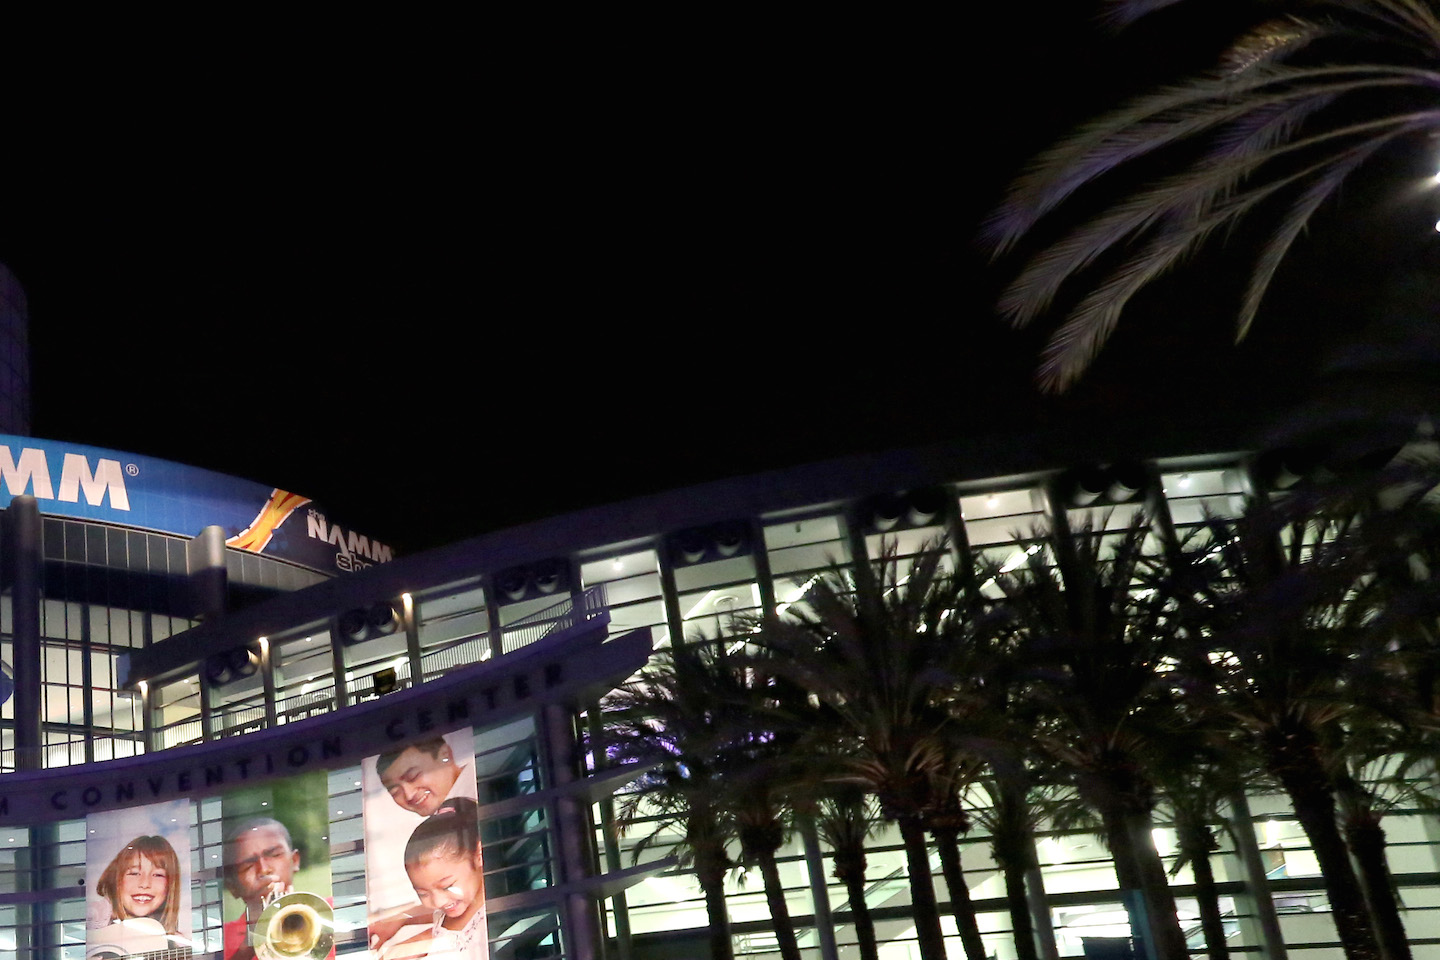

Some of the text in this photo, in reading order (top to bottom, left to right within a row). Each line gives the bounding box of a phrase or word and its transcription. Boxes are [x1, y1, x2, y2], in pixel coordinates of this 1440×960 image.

[307, 515, 393, 563] NAMM
[51, 737, 343, 811] CONVENTION
[386, 663, 562, 741] CENTER
